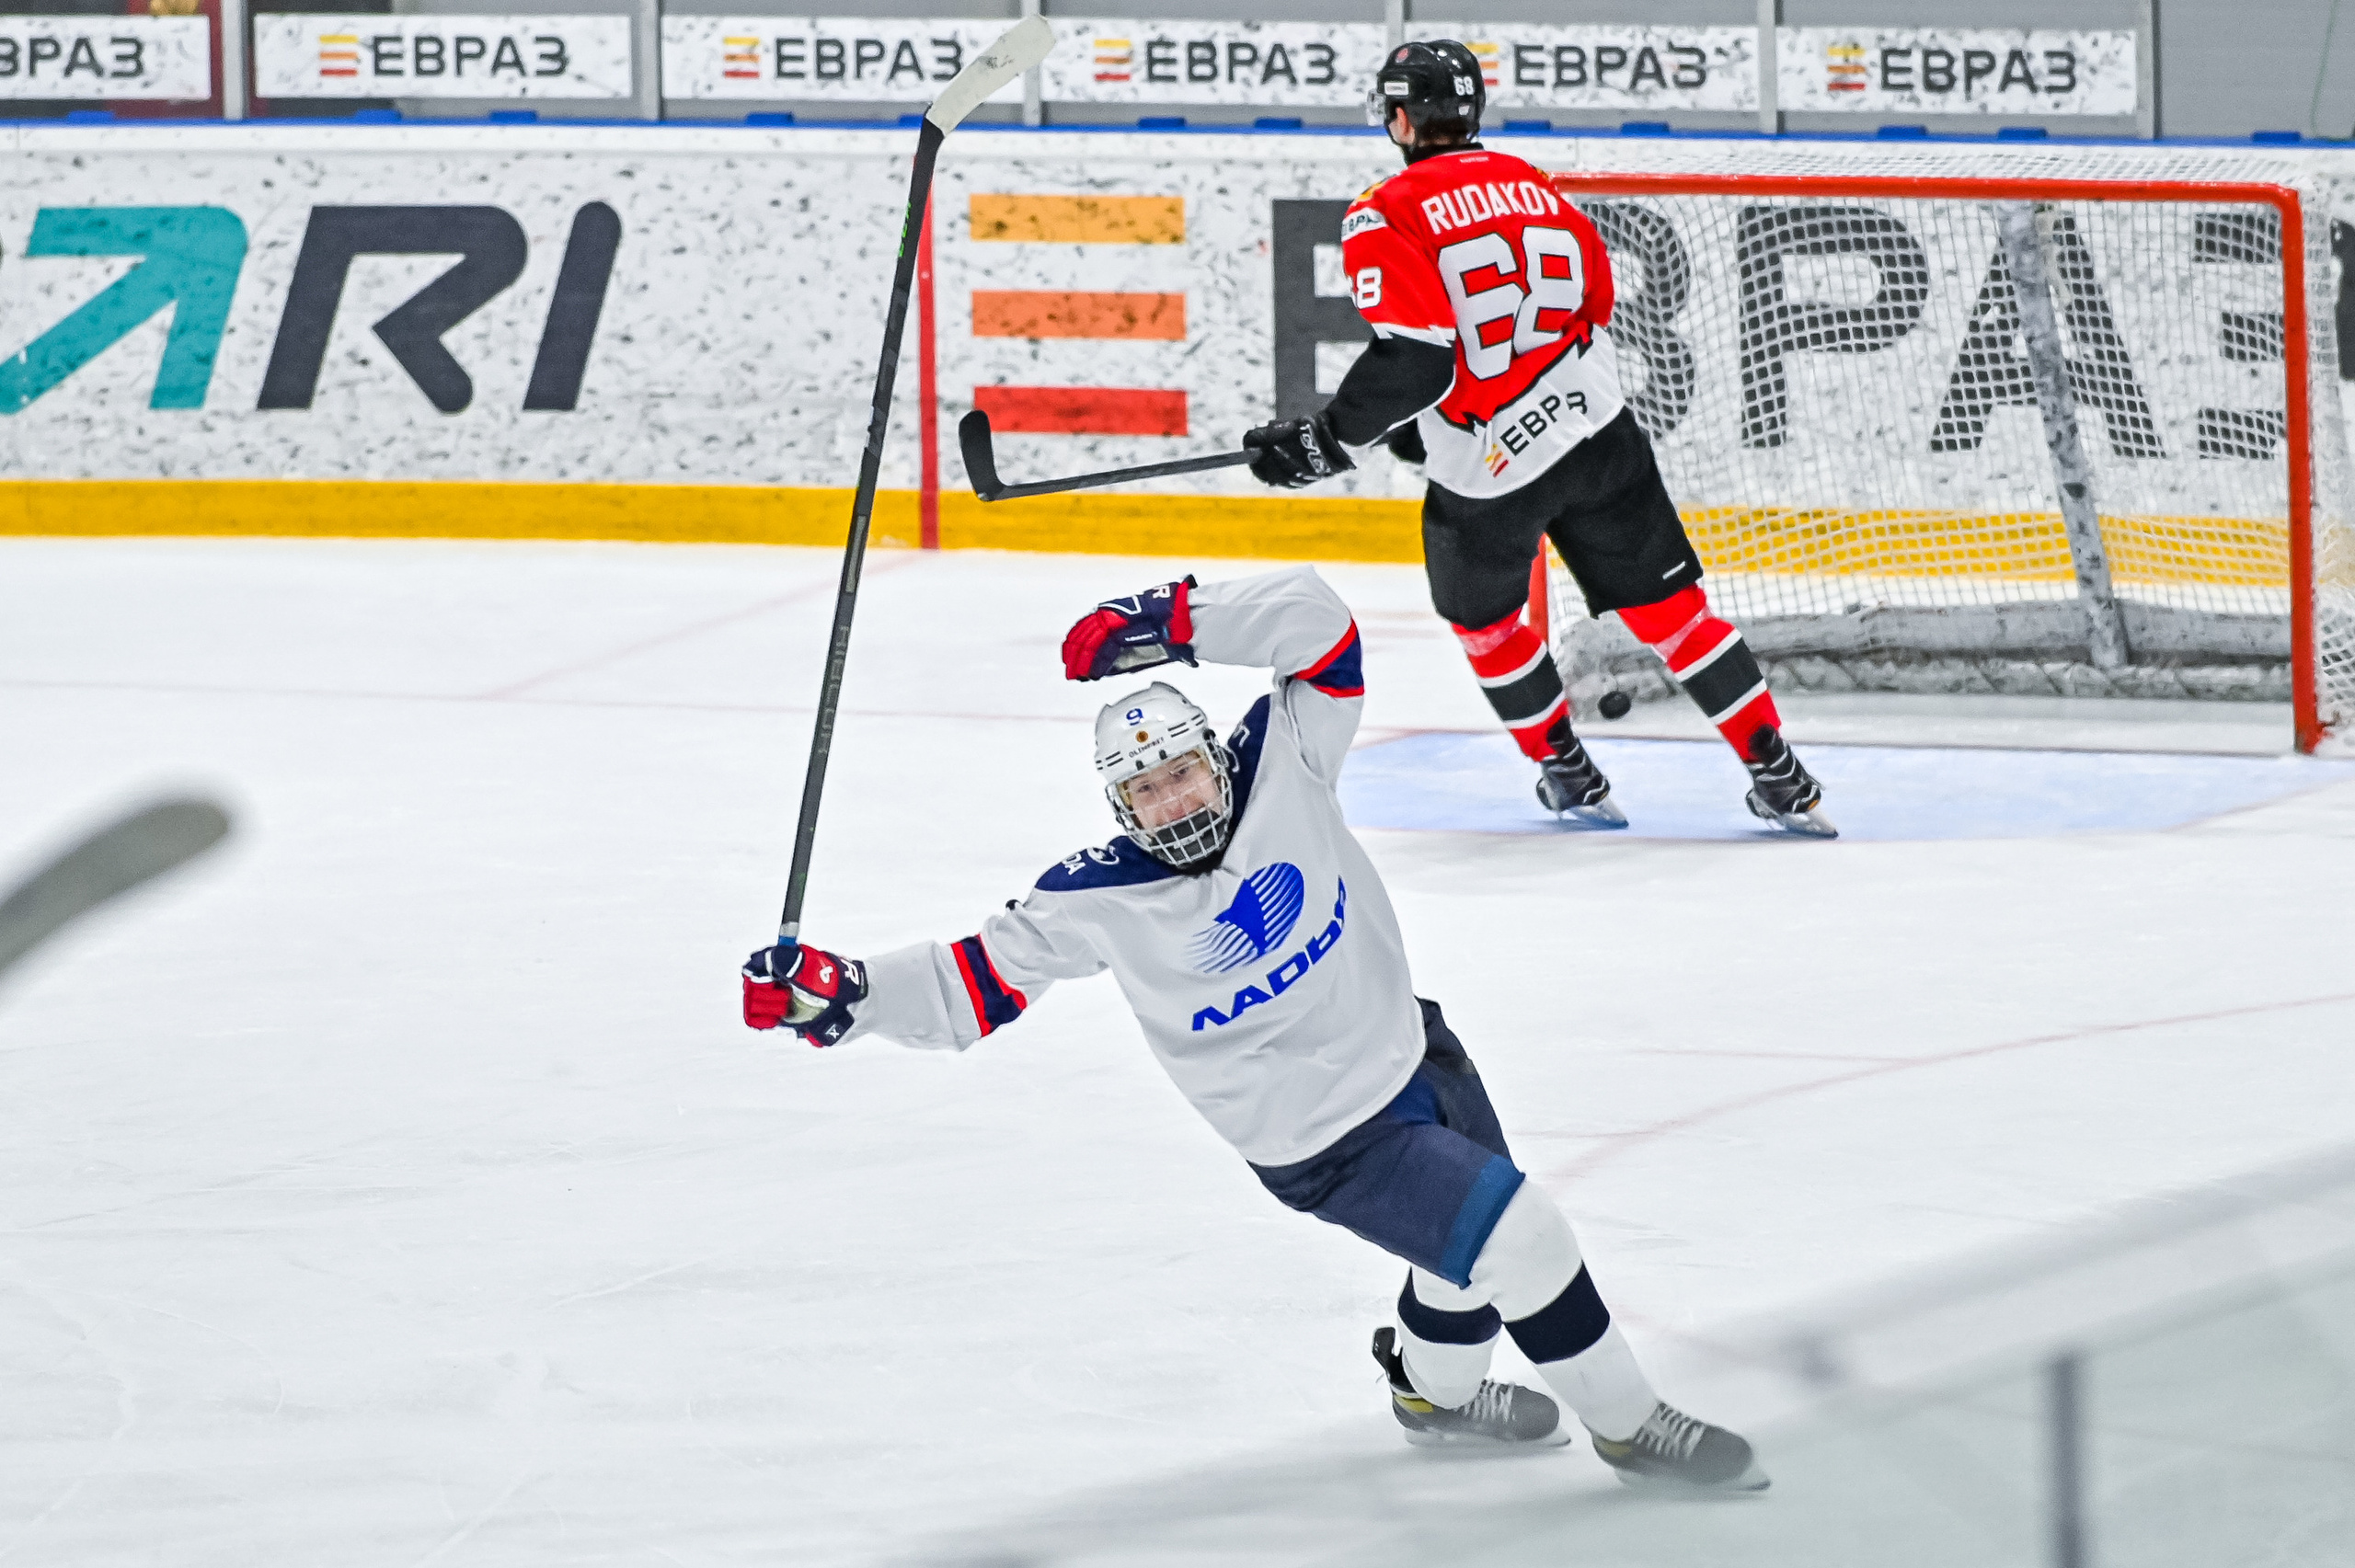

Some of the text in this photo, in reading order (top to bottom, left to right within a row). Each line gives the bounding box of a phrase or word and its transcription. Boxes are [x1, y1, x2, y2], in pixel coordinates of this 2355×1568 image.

[373, 36, 569, 76] ЕВРАЗ
[775, 38, 963, 81] ЕВРАЗ
[1146, 40, 1337, 85] ЕВРАЗ
[1514, 43, 1707, 90] ЕВРАЗ
[1879, 48, 2077, 94] ЕВРАЗ
[1453, 75, 1475, 96] 68
[1421, 181, 1559, 235] RUDAKOV
[0, 201, 622, 415] ARI
[1349, 266, 1383, 310] 8
[1438, 225, 1585, 381] 68
[1125, 707, 1144, 727] 9
